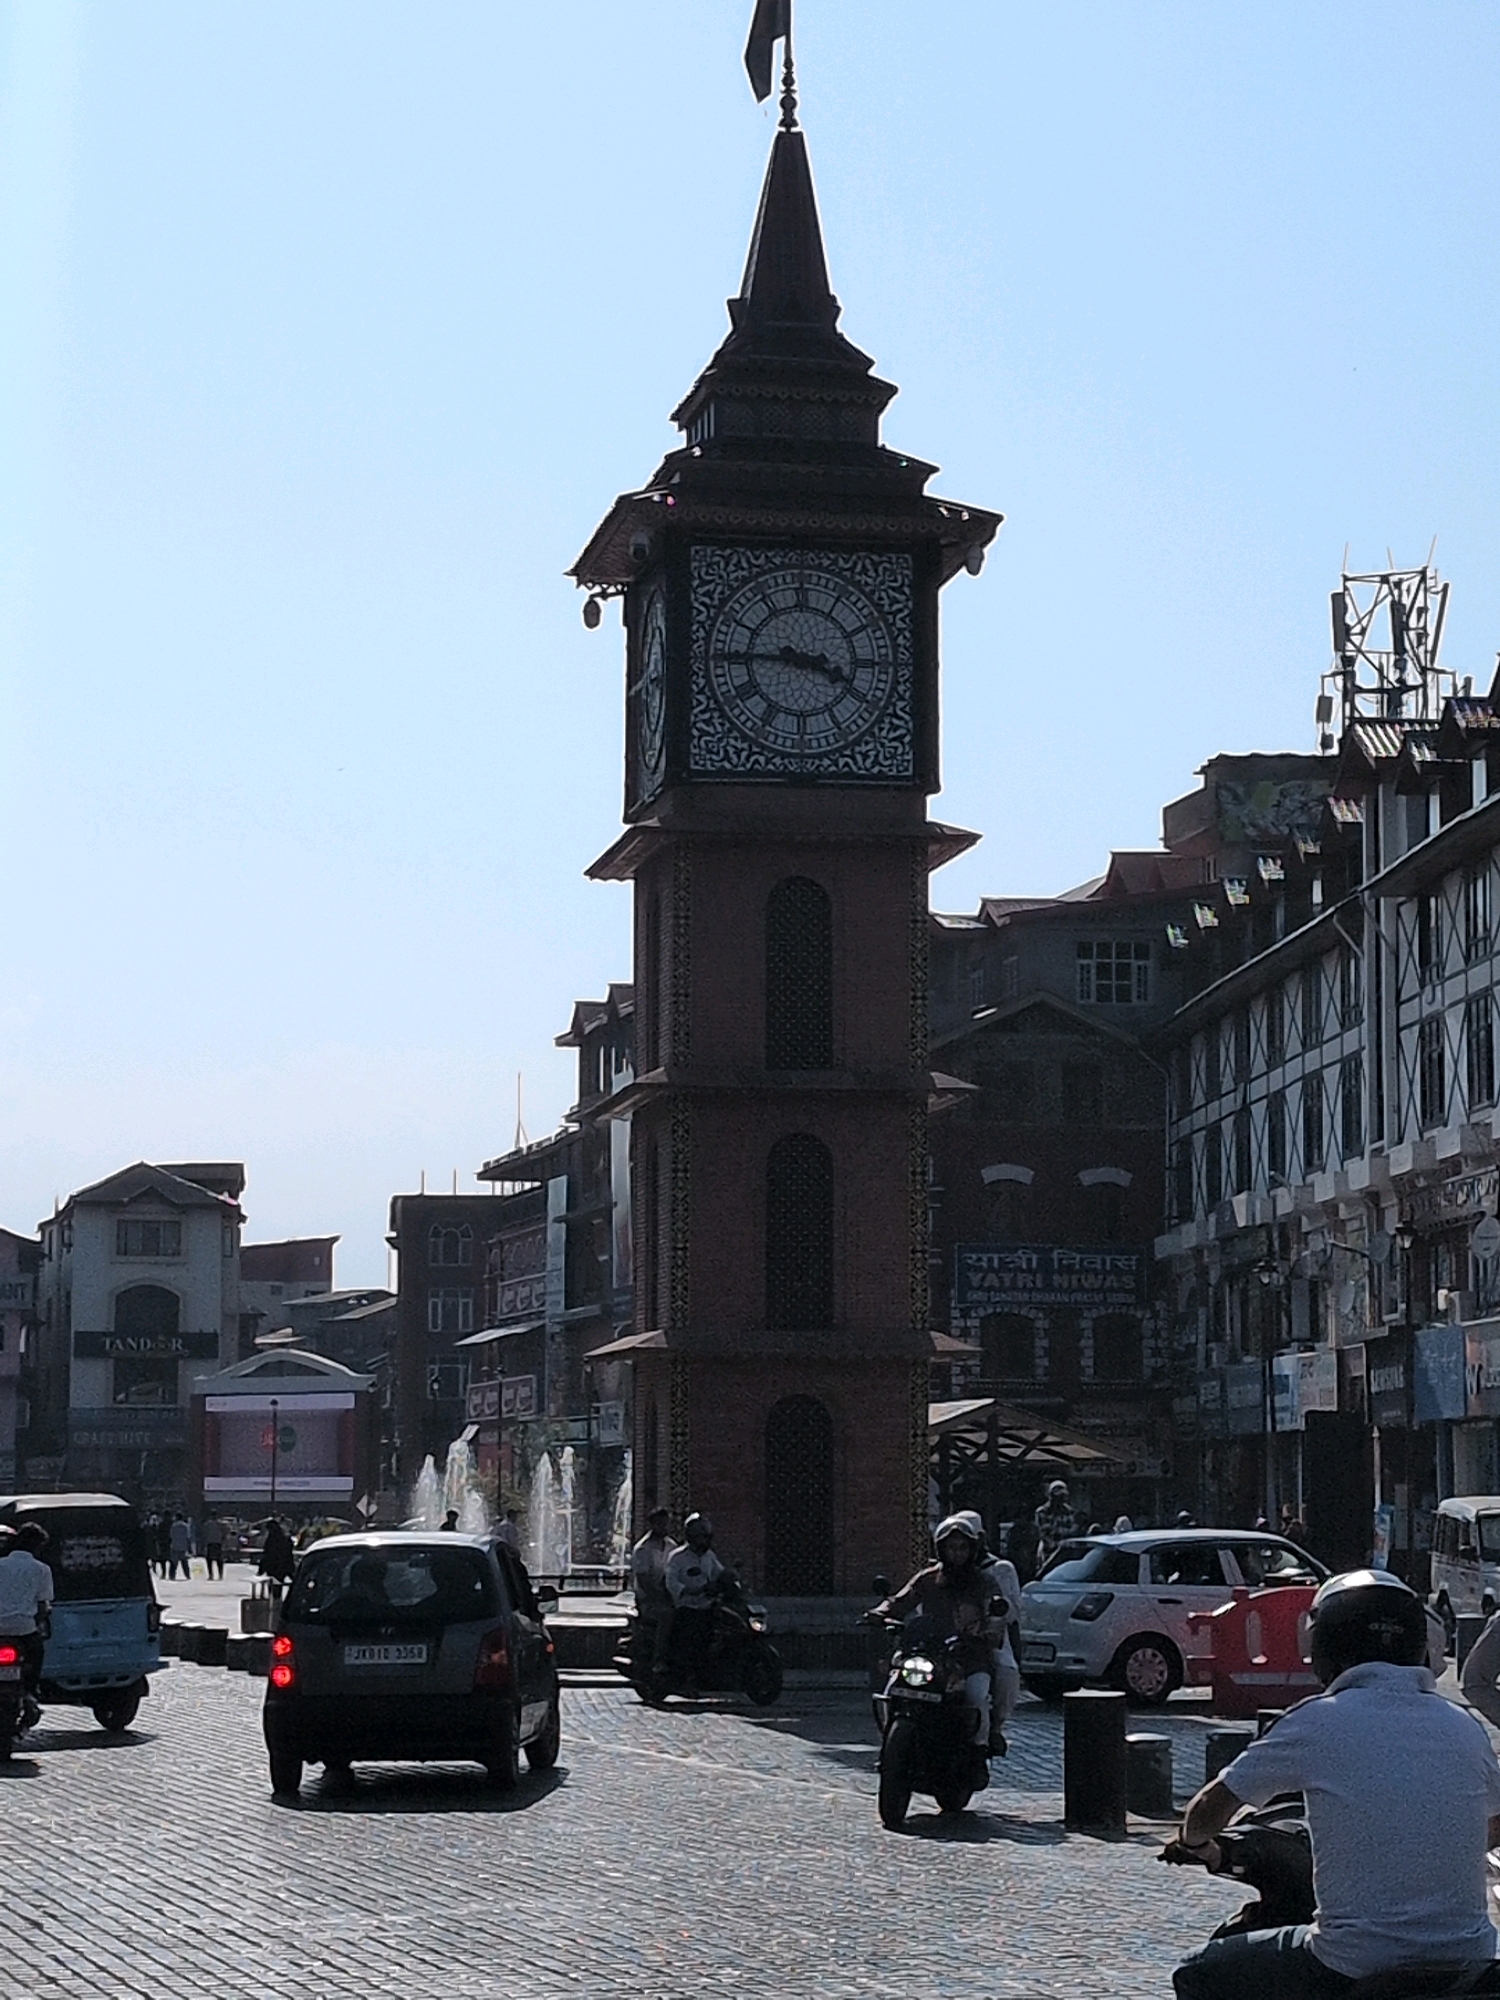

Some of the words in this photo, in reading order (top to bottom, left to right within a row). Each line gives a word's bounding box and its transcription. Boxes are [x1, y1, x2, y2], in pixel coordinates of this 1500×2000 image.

[962, 1249, 1040, 1270] यात्री
[1051, 1249, 1139, 1271] निवास
[966, 1271, 1043, 1290] YATRI
[1051, 1272, 1137, 1291] NIWAS
